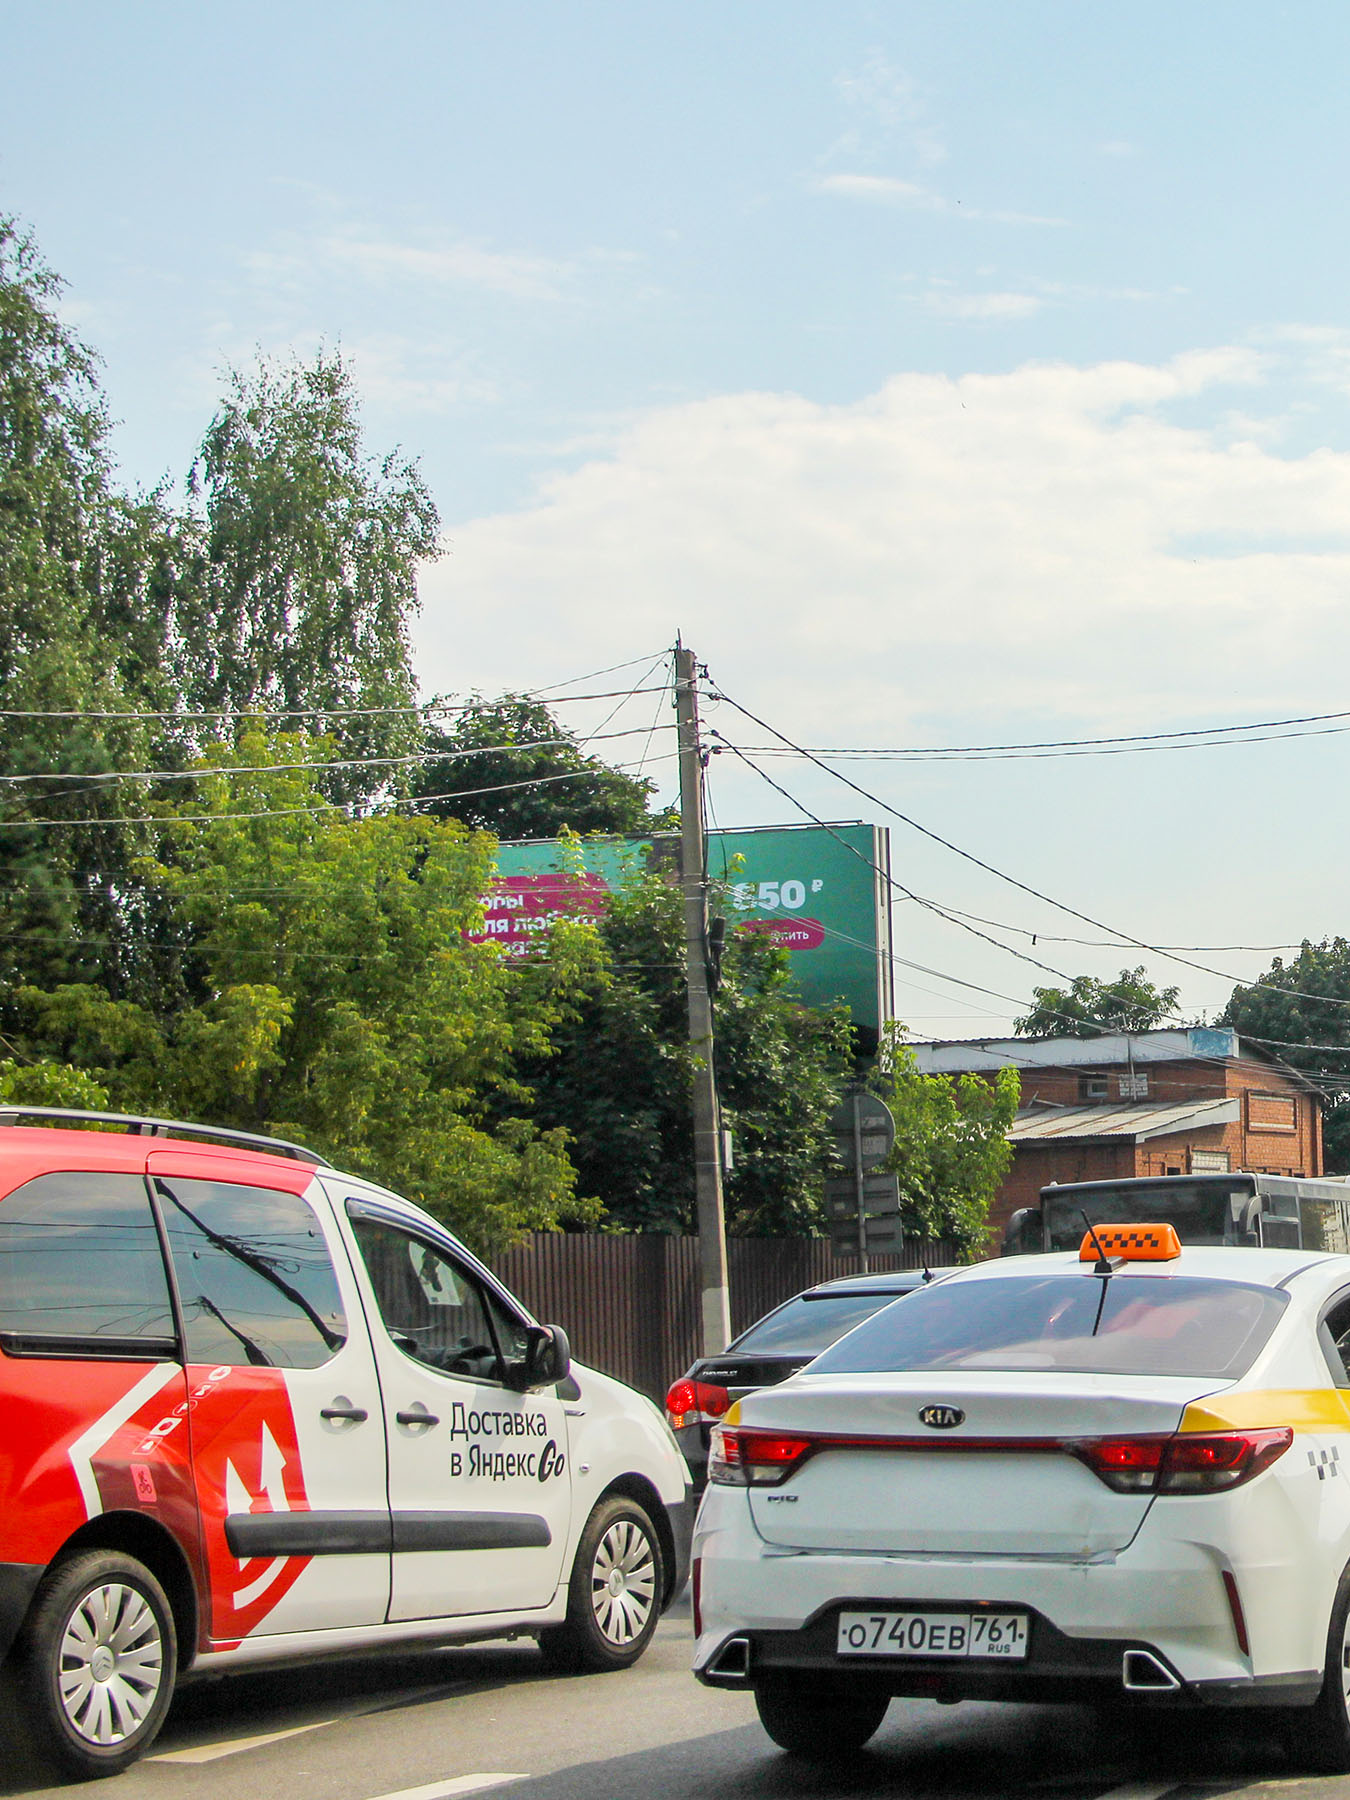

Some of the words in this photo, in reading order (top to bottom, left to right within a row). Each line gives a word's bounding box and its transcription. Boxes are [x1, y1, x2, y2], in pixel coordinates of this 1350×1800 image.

[450, 1401, 547, 1441] Доставка
[924, 1409, 956, 1424] KIA
[450, 1452, 462, 1476] в
[469, 1444, 536, 1481] Яндекс
[538, 1439, 565, 1483] Go
[848, 1616, 967, 1651] О740ЕВ
[973, 1617, 1019, 1643] 761
[987, 1643, 1011, 1654] RUS
